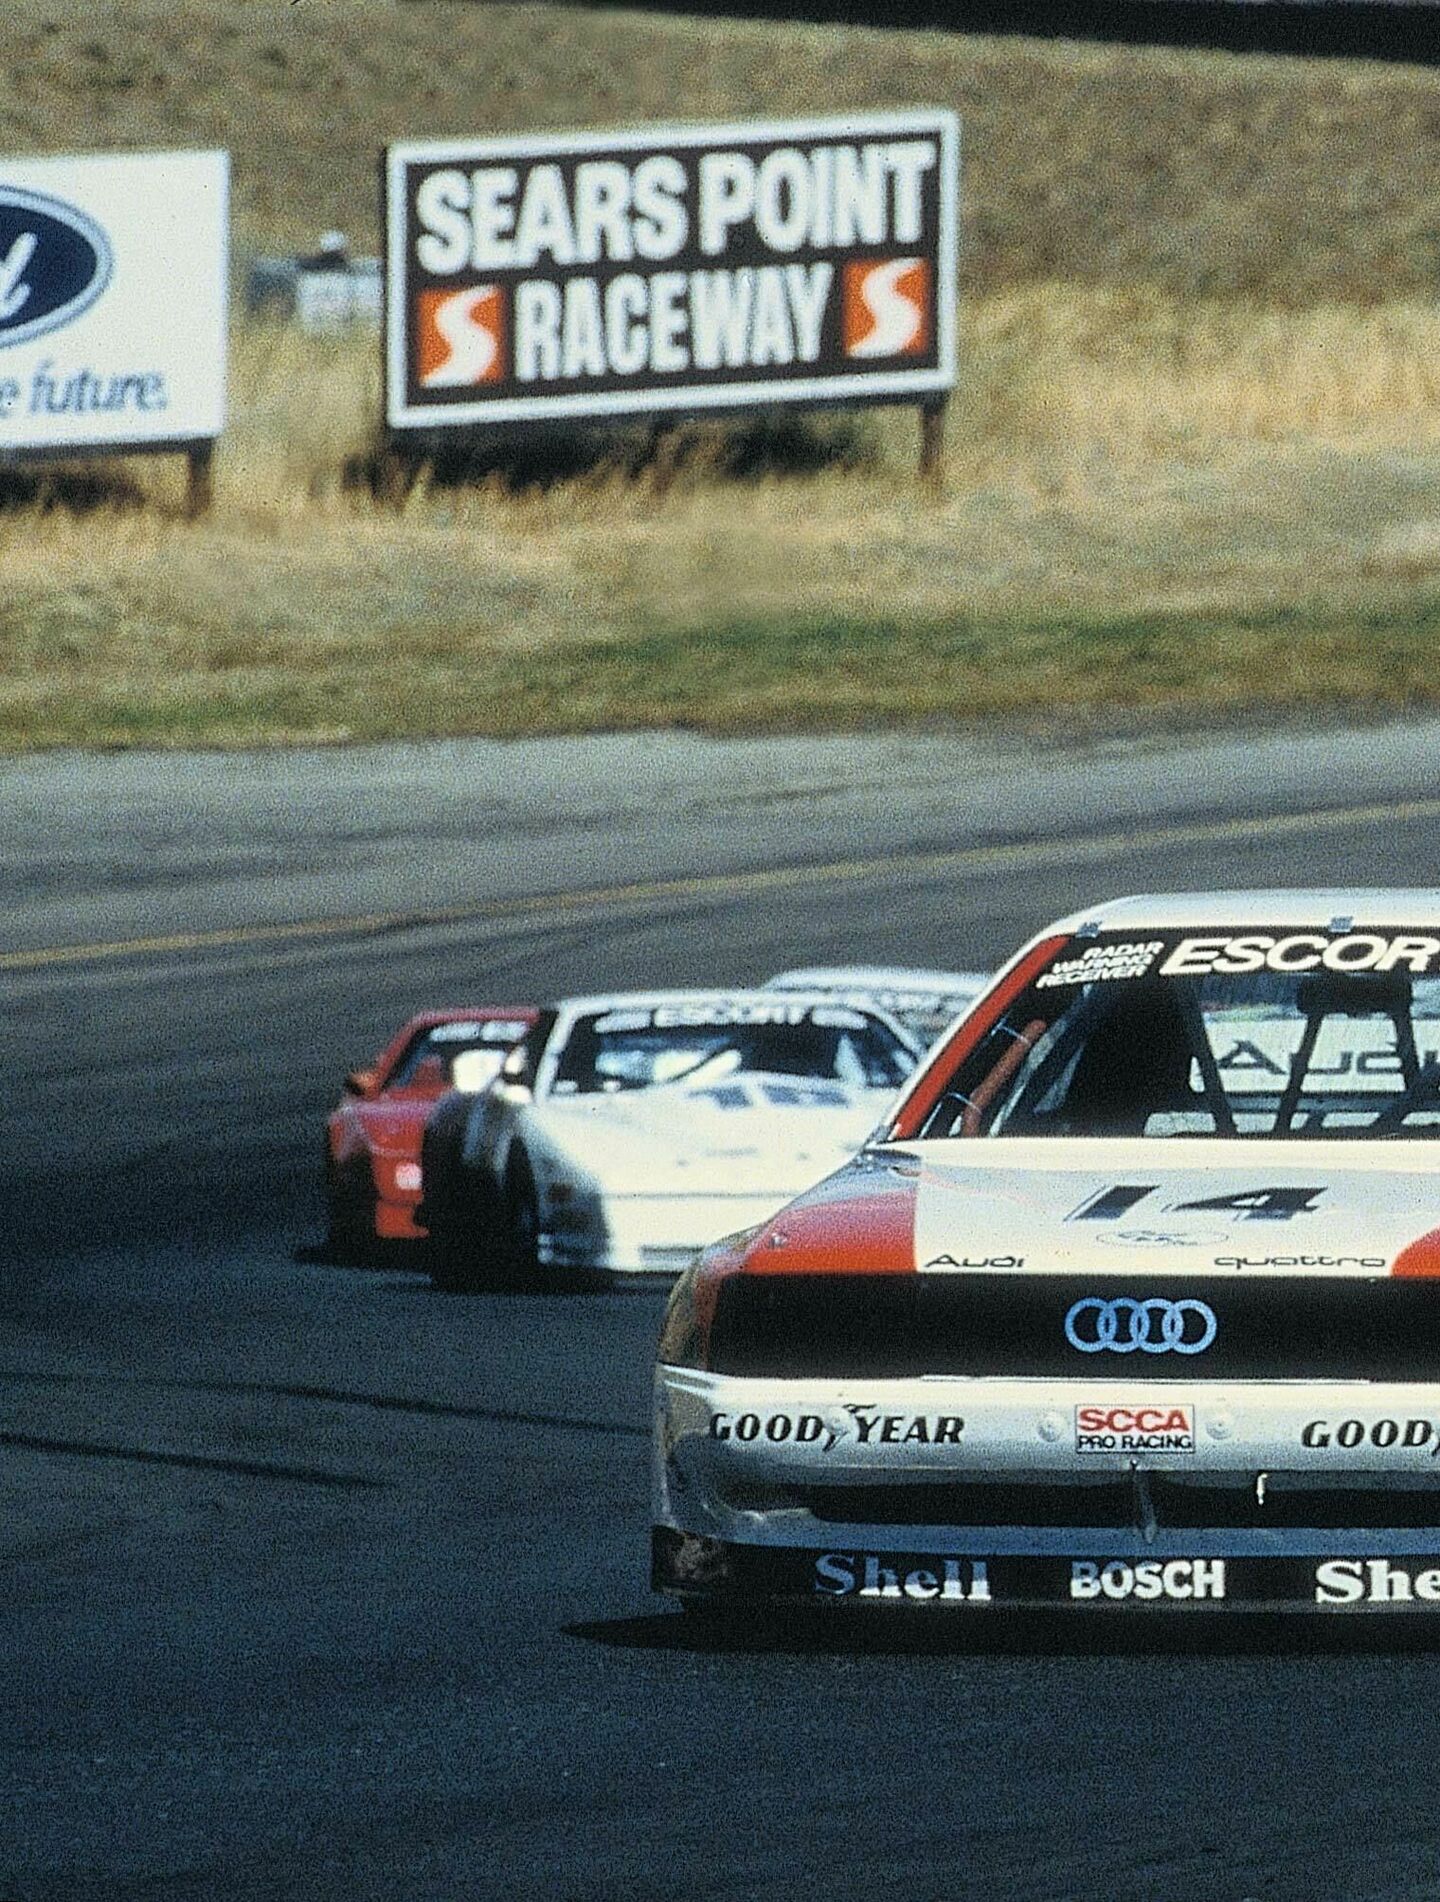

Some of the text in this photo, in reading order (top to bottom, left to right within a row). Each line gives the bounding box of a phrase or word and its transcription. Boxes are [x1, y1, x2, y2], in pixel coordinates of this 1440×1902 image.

[414, 142, 936, 274] SEARS POINT
[514, 262, 833, 381] RACEWAY
[1083, 941, 1165, 960] RADAR
[1052, 953, 1155, 974] WARNING
[1036, 965, 1148, 988] RECEIVER
[1214, 1254, 1387, 1271] quattro
[1078, 1408, 1189, 1433] SCCA
[1078, 1434, 1193, 1451] PRO RACING
[813, 1553, 993, 1602] Shell
[1069, 1559, 1226, 1600] BOSCH
